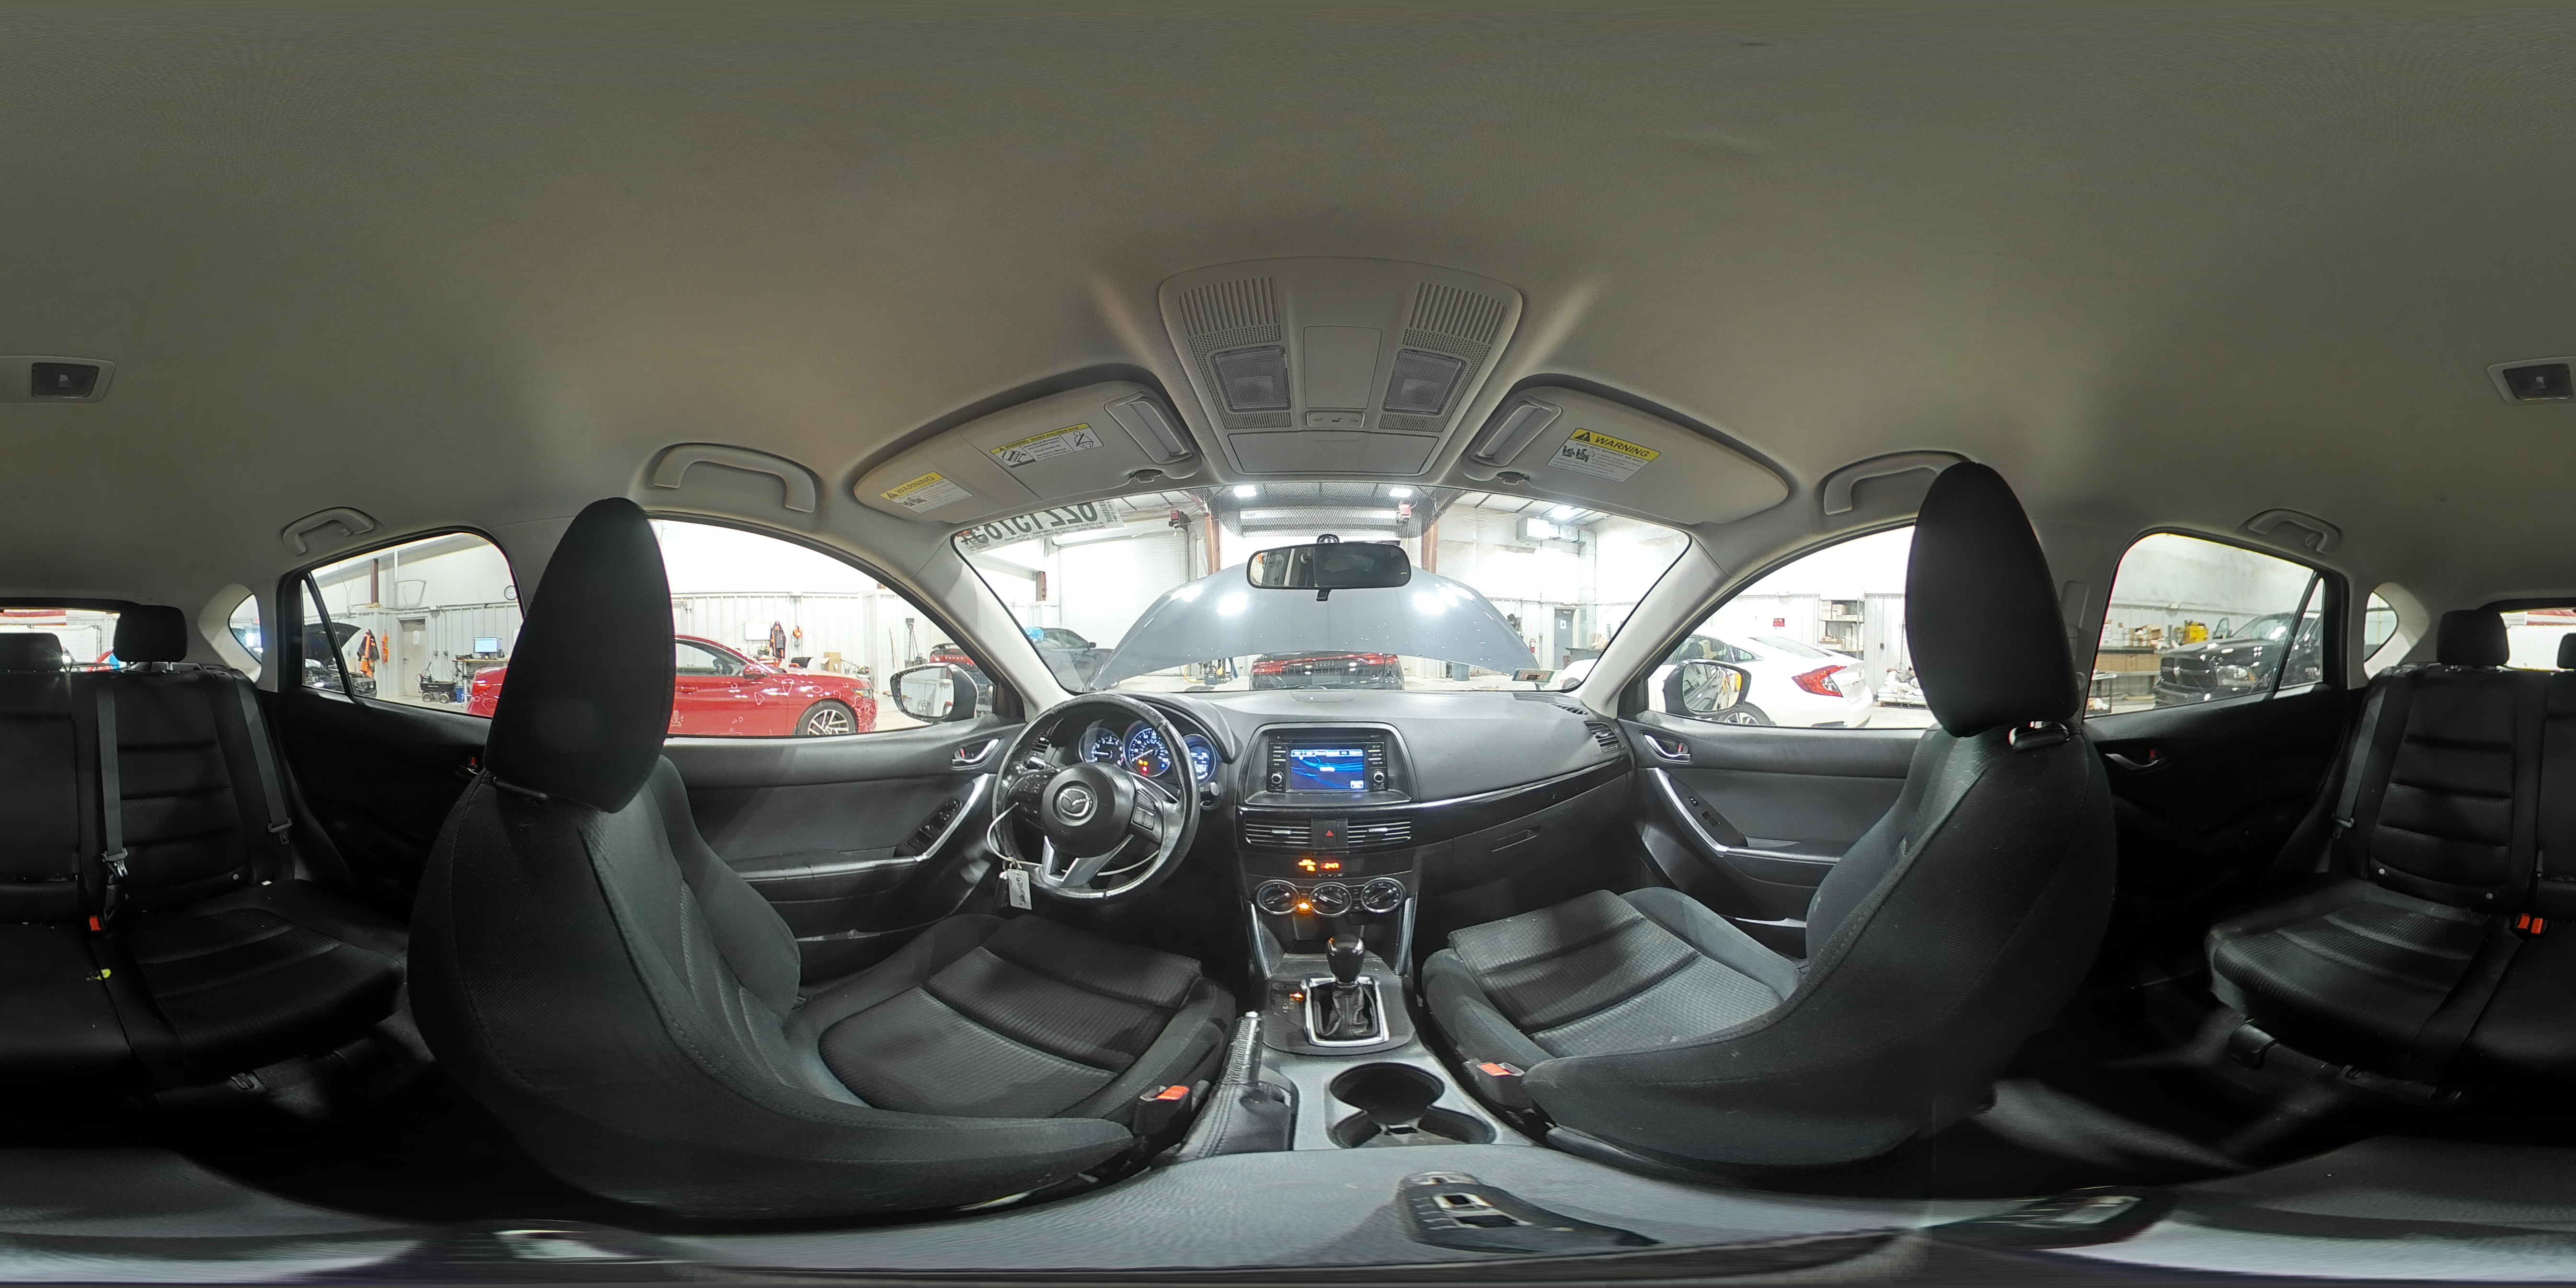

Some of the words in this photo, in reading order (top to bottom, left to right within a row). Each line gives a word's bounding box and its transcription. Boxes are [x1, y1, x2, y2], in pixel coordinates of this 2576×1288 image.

[1046, 429, 1068, 438] ROLLOVER
[1595, 436, 1650, 458] WARNING
[894, 476, 935, 494] WARNING
